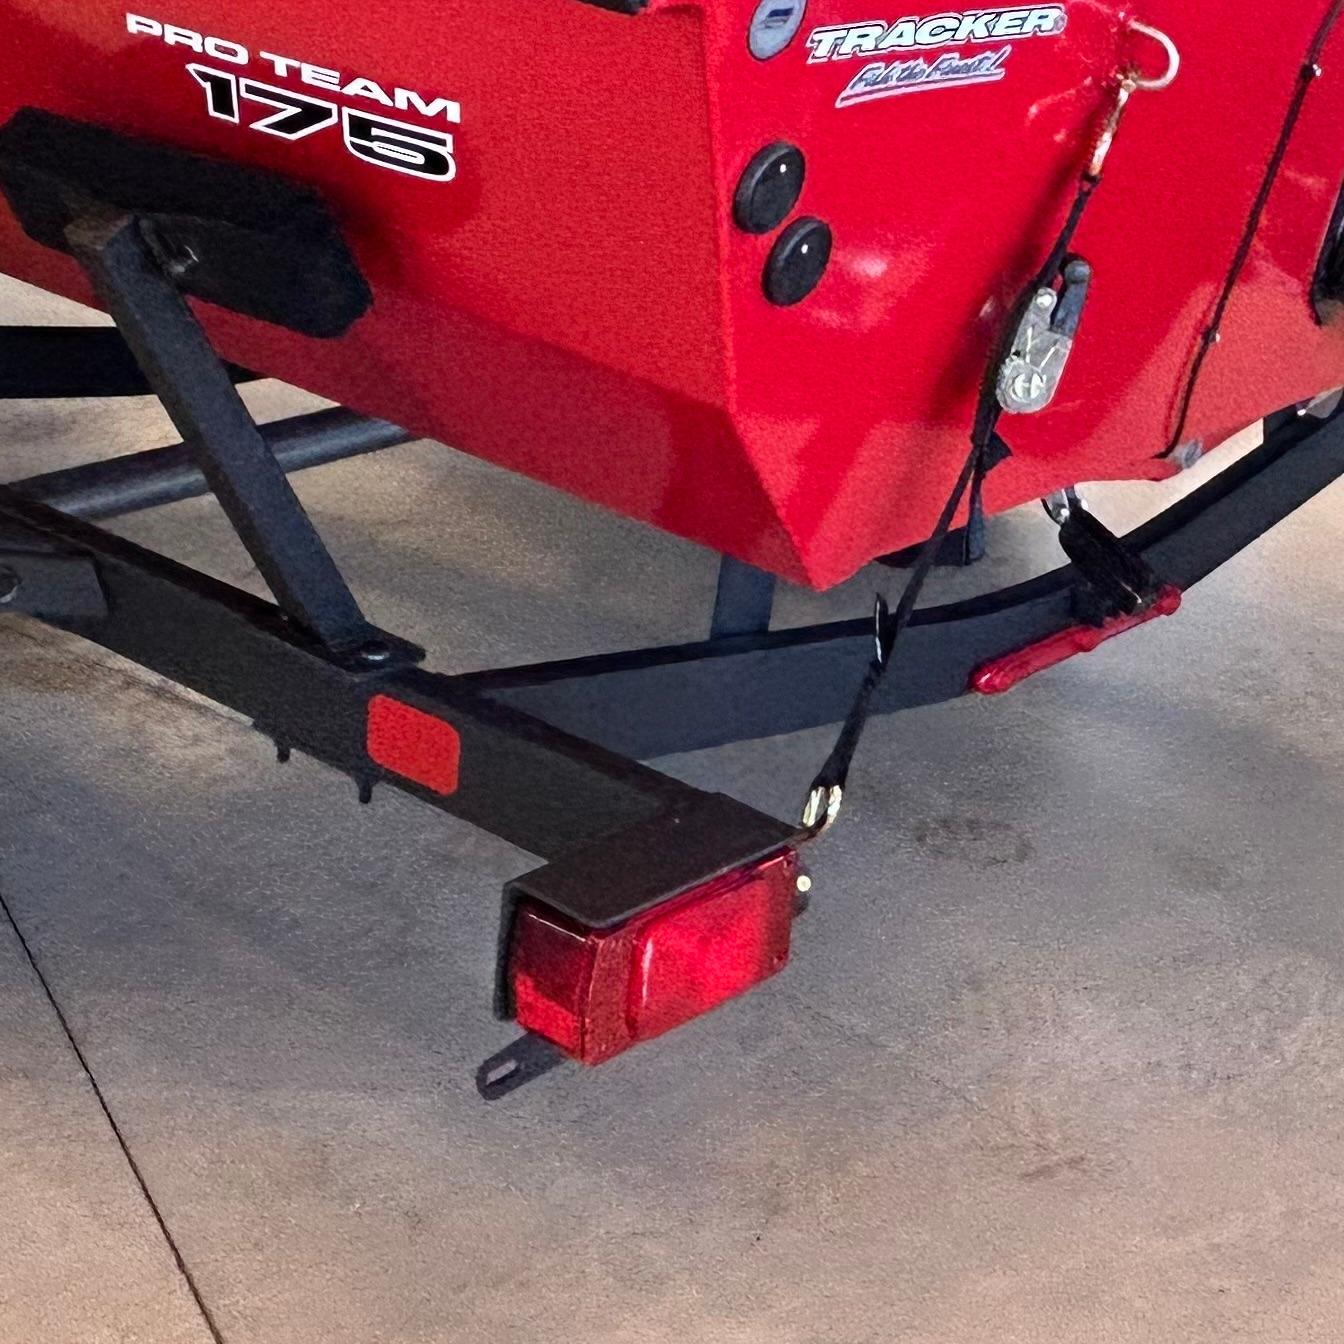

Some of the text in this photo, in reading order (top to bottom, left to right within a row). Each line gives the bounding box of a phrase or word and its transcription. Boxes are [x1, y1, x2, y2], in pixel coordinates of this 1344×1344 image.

[125, 12, 461, 124] PRO TEAM
[811, 5, 1067, 62] TRACKER
[185, 62, 457, 183] 175
